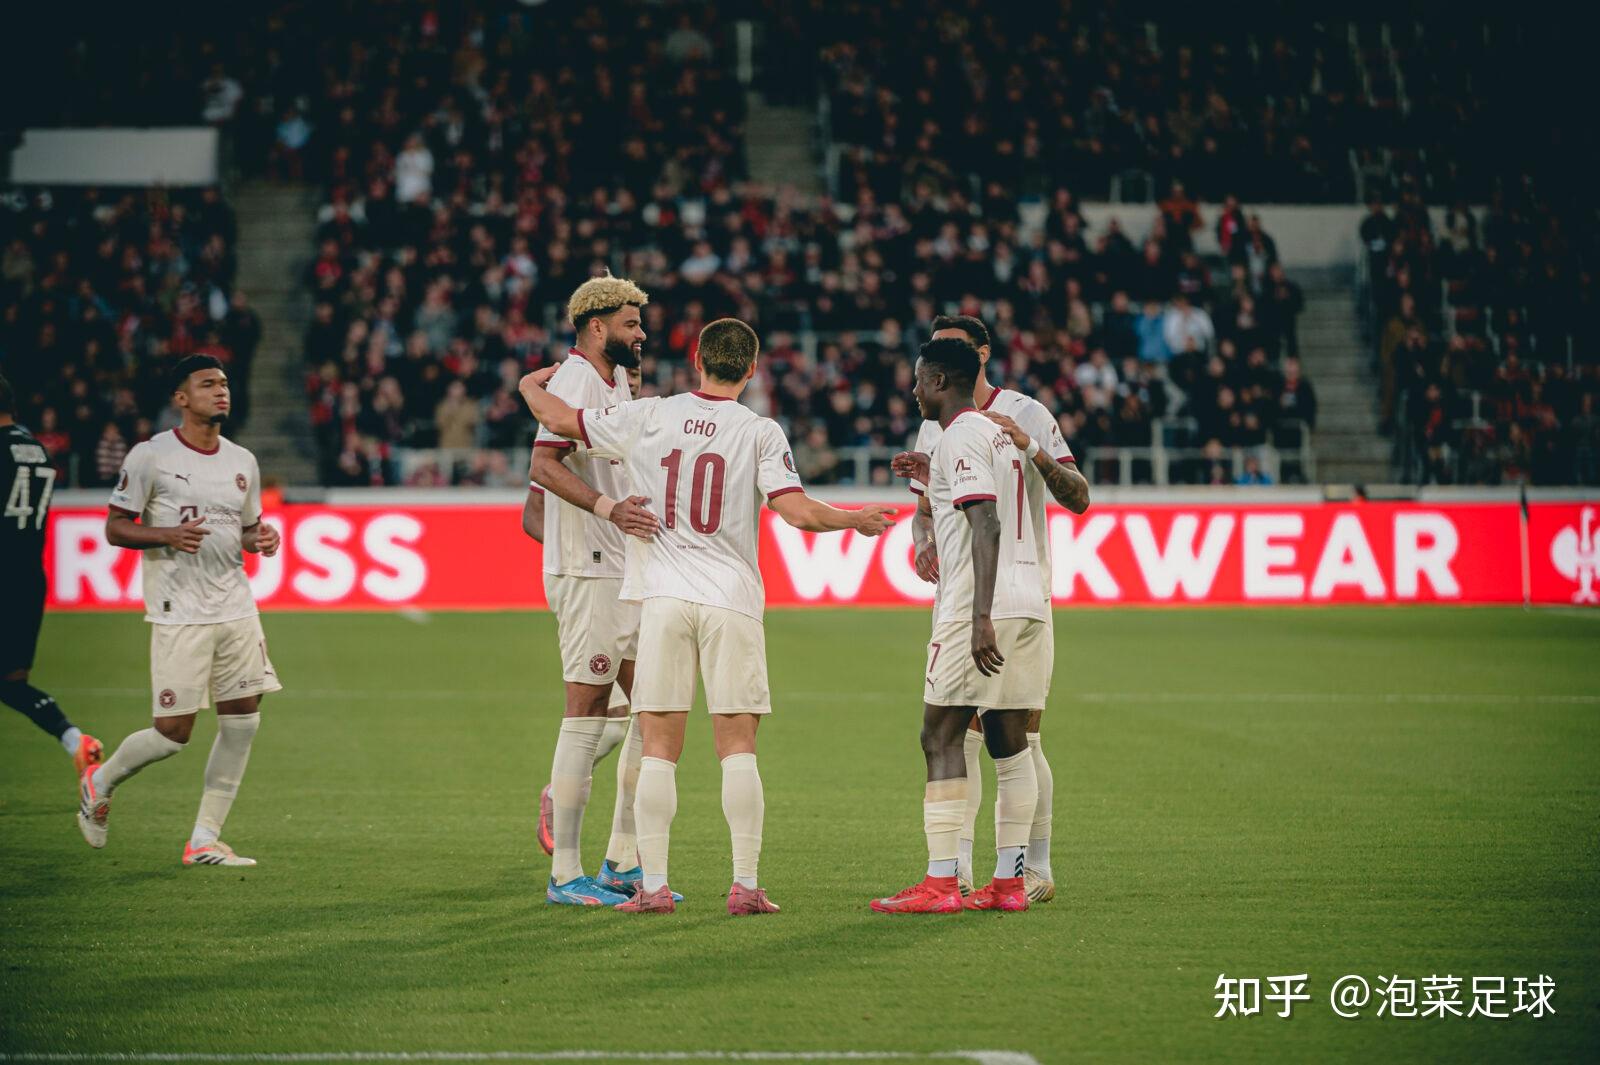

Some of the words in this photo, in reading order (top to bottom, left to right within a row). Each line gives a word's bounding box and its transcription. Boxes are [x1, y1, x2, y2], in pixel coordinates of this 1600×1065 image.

[683, 418, 717, 438] CHO
[4, 465, 57, 530] 47
[660, 448, 726, 535] 10
[770, 511, 1462, 601] WOKWEAR
[929, 642, 941, 673] 7
